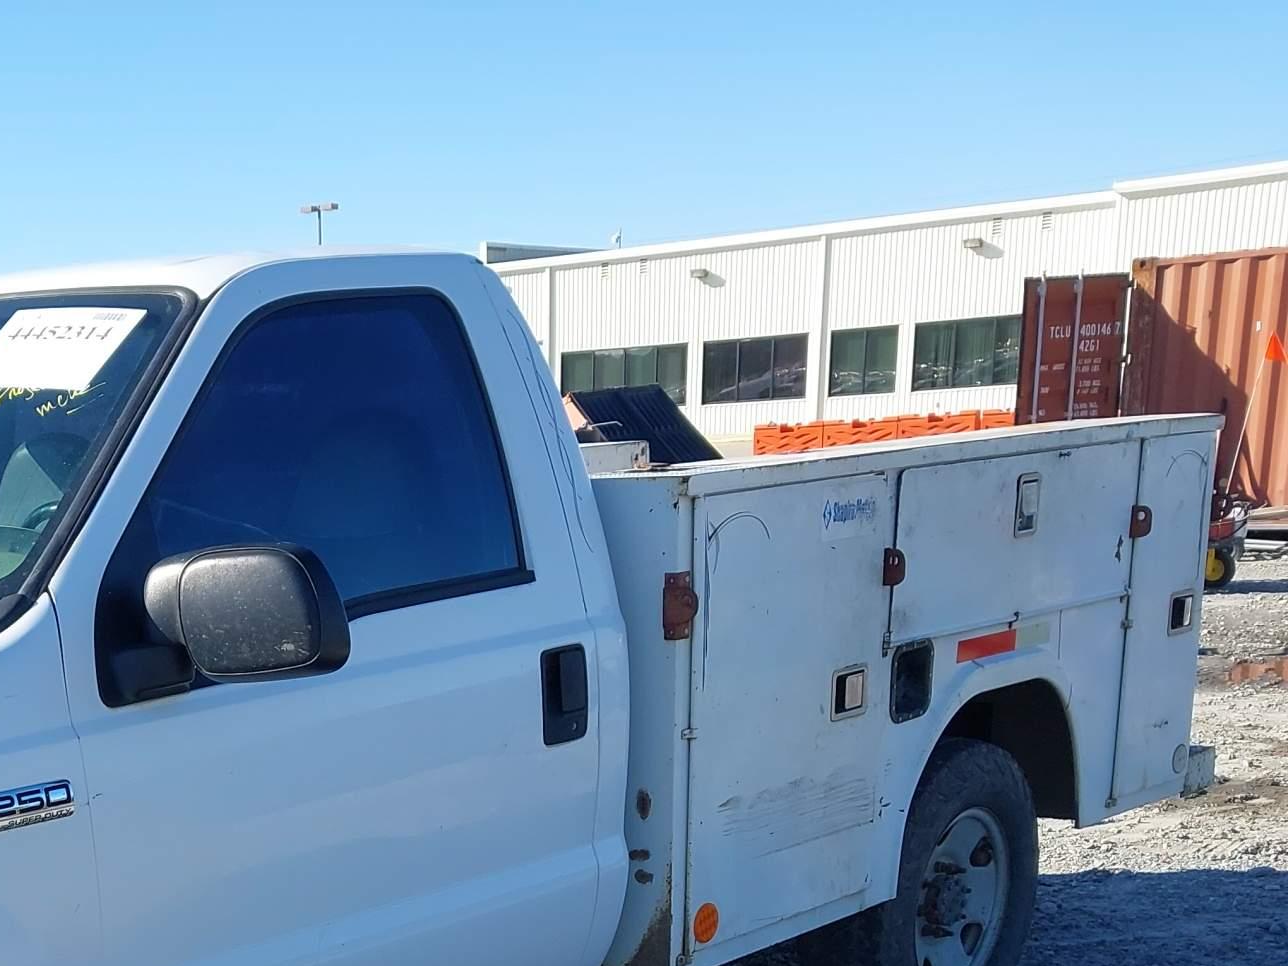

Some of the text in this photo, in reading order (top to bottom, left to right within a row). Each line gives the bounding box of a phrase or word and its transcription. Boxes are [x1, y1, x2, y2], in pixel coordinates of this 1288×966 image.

[8, 325, 114, 341] 44452314
[1050, 325, 1071, 338] TCLU
[1080, 323, 1112, 337] 400146
[7, 814, 43, 828] SUPER
[44, 808, 72, 821] DUTY
